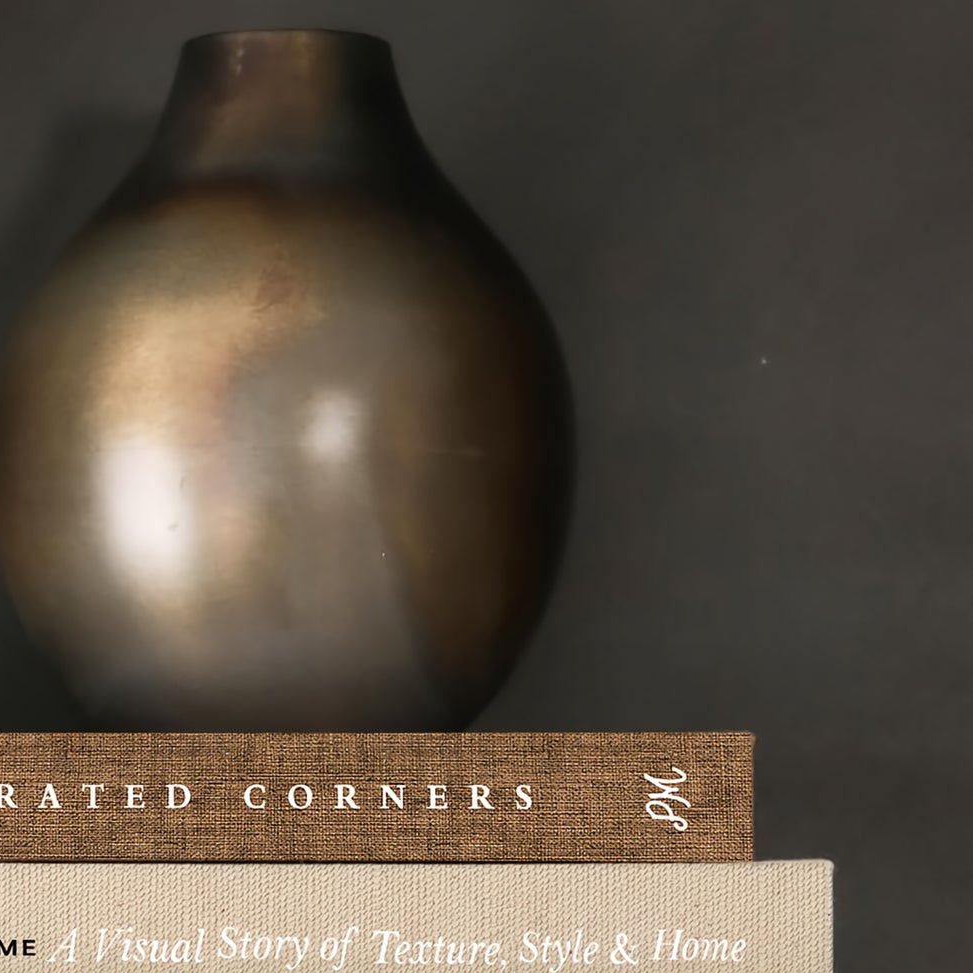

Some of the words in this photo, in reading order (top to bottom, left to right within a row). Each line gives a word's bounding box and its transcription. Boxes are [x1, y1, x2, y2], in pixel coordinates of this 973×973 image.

[243, 784, 534, 811] CORNERS
[47, 928, 78, 963] A
[95, 928, 205, 964] Visual
[217, 927, 309, 970] Story
[319, 926, 359, 971] of
[371, 930, 508, 969] Texture,
[519, 931, 598, 973] Style
[609, 932, 639, 965] &
[652, 929, 747, 962] Home
